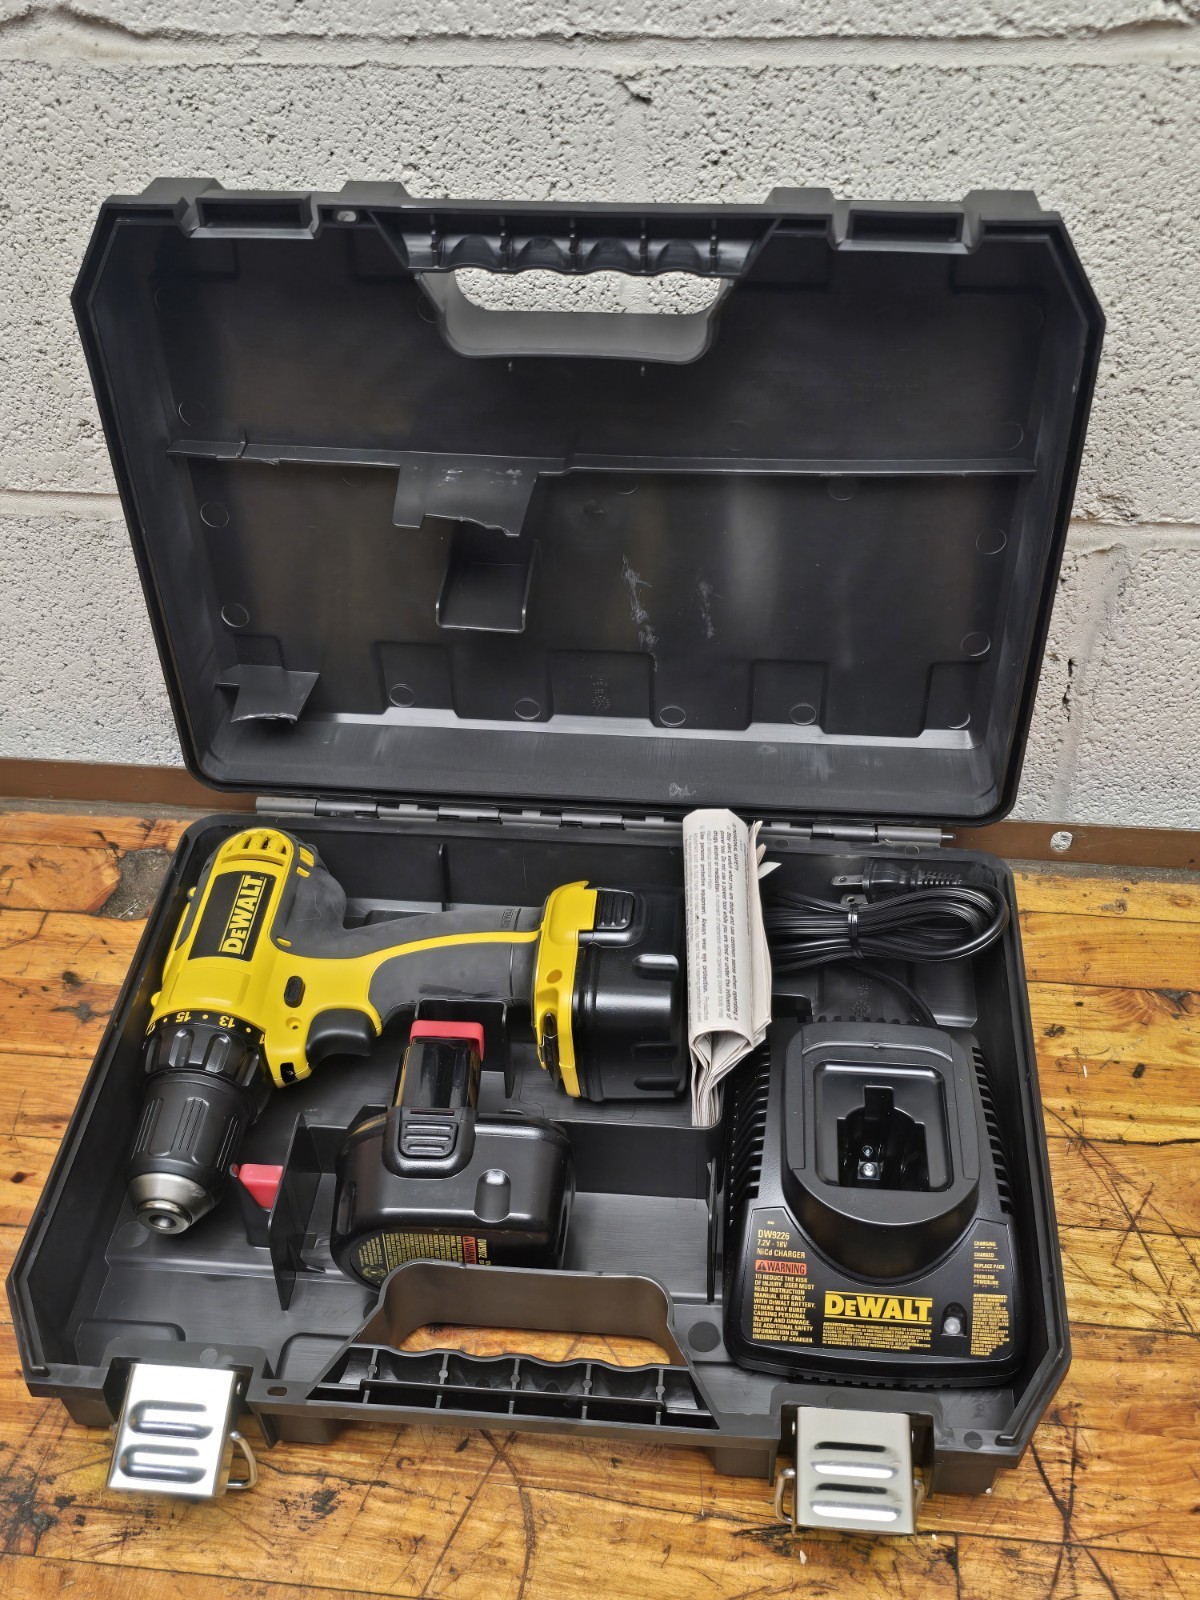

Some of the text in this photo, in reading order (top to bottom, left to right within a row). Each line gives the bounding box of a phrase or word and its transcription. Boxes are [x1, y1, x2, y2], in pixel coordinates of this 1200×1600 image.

[176, 1012, 191, 1022] 15
[219, 1016, 235, 1028] 13
[758, 1230, 790, 1240] DW9226
[465, 1243, 475, 1264] WARNIN
[774, 1250, 806, 1258] CHARGER
[767, 1262, 805, 1274] WARNING
